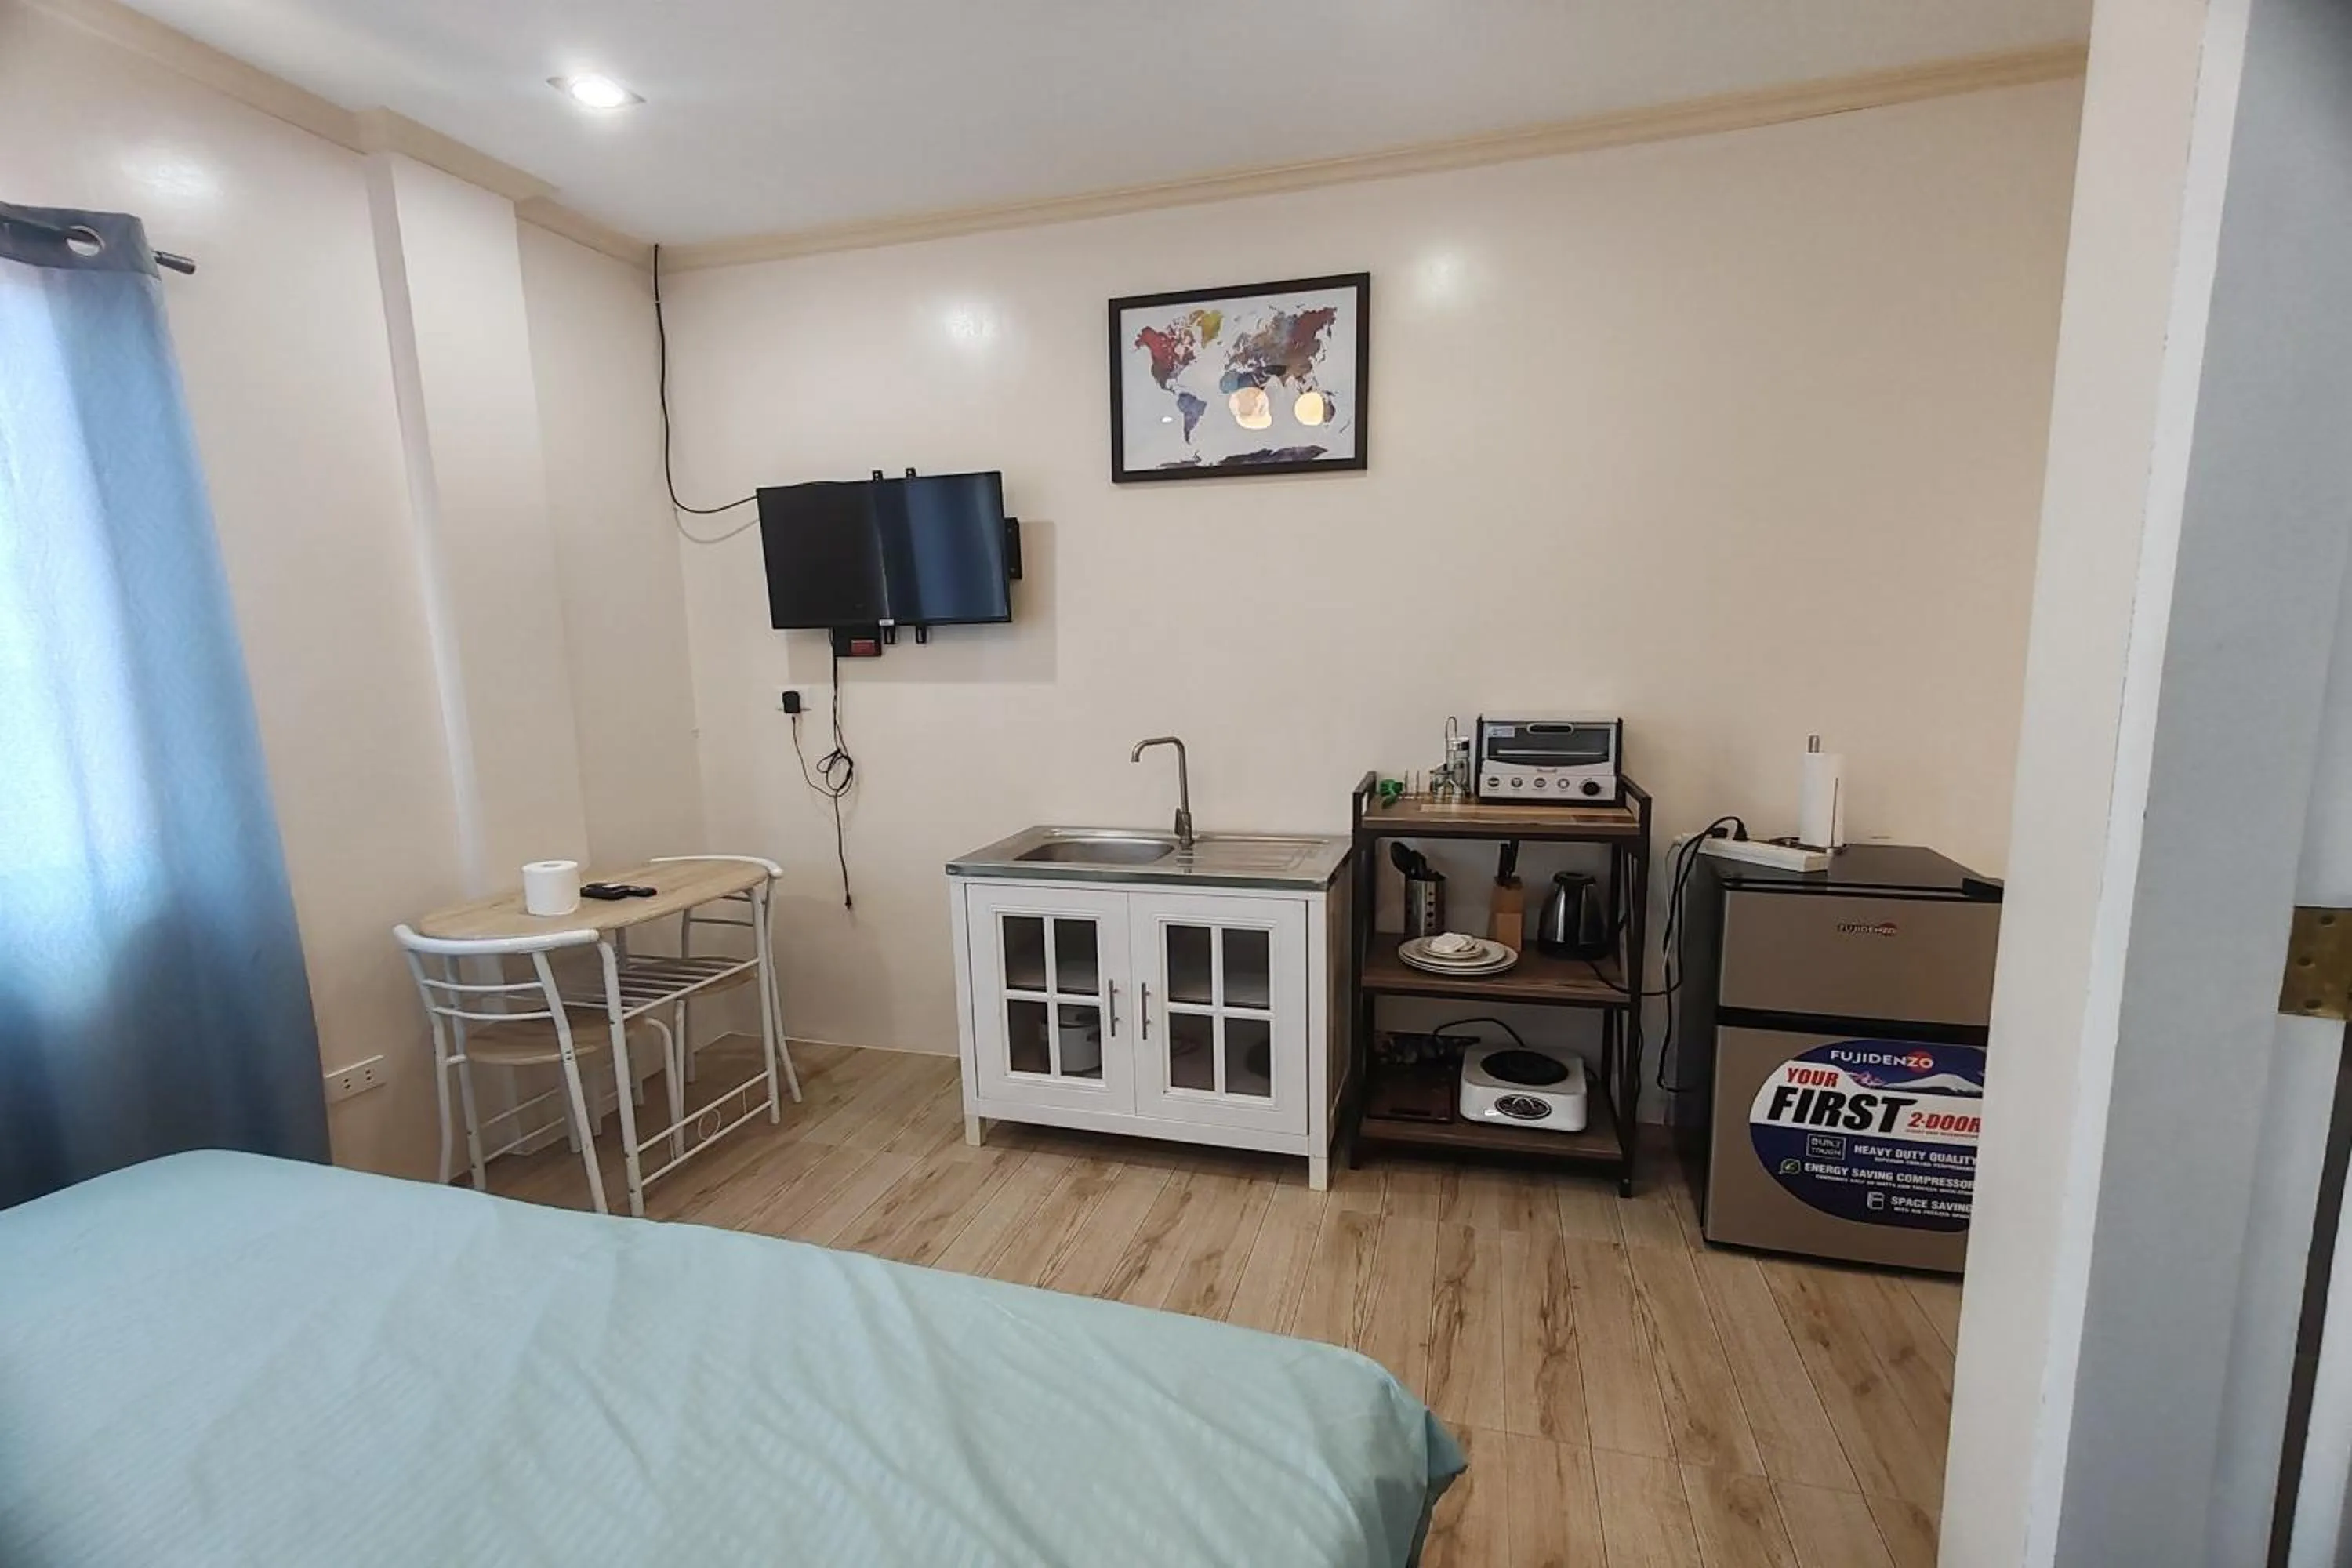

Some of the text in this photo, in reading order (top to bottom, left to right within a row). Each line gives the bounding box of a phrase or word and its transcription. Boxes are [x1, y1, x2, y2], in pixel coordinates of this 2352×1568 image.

[1831, 1050, 1934, 1068] FUJIDENZO
[1788, 1068, 1838, 1087] YOUR
[1767, 1086, 1981, 1133] FIRST 2-DOOR
[1853, 1145, 1893, 1156] HEAVY
[1895, 1149, 1926, 1160] DUTY
[1804, 1163, 1848, 1176] ENERGY
[1852, 1168, 1893, 1181] SAVING
[1890, 1196, 1927, 1208] SPACE
